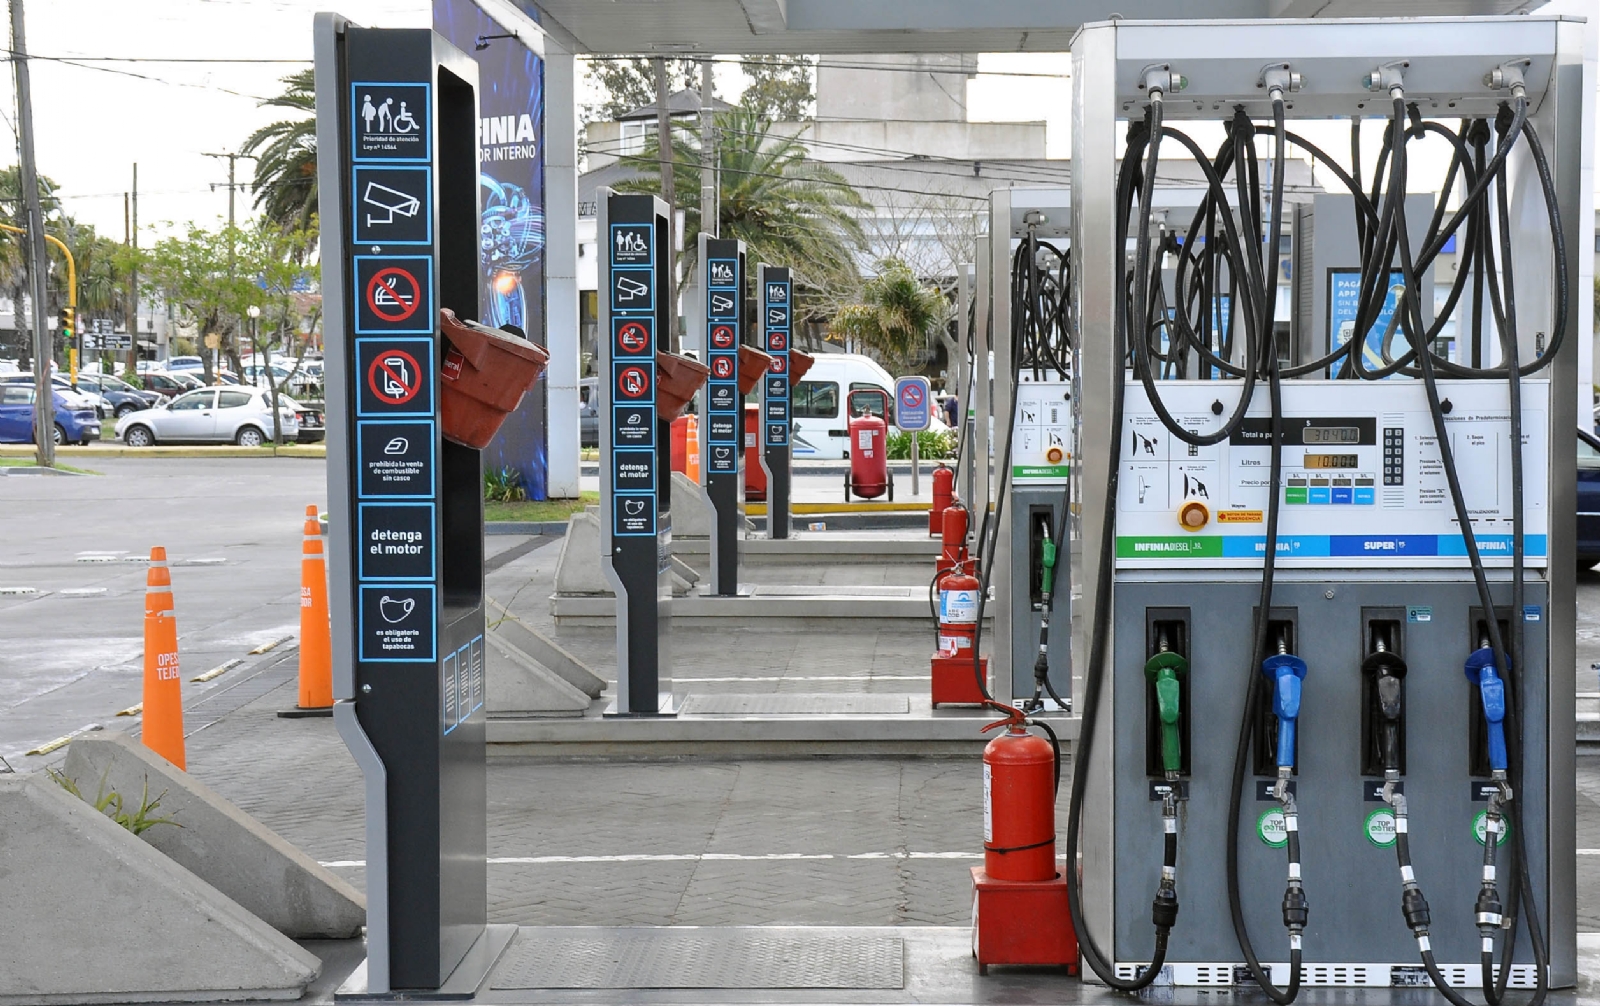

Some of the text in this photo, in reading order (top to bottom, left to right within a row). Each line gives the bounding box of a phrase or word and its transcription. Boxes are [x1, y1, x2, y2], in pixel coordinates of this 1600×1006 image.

[494, 144, 536, 160] INTERNO
[1318, 456, 1356, 467] 10.000
[371, 530, 422, 542] detenga
[370, 543, 424, 554] el motor
[1255, 542, 1290, 551] INNIA
[1364, 542, 1395, 550] SUPER
